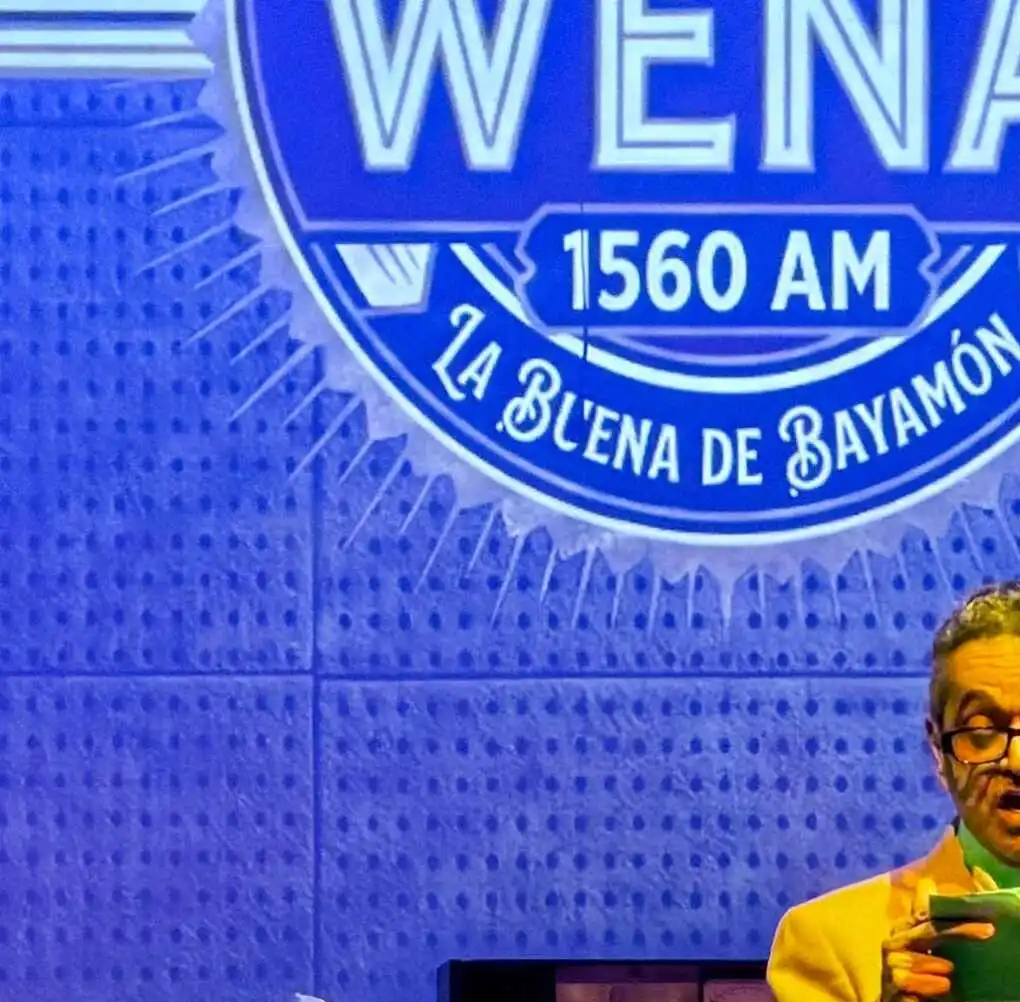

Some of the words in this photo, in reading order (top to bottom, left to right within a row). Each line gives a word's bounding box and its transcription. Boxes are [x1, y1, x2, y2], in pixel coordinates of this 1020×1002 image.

[562, 229, 748, 312] 1560
[770, 229, 891, 311] AM
[431, 303, 503, 401] LA
[701, 427, 764, 486] DE
